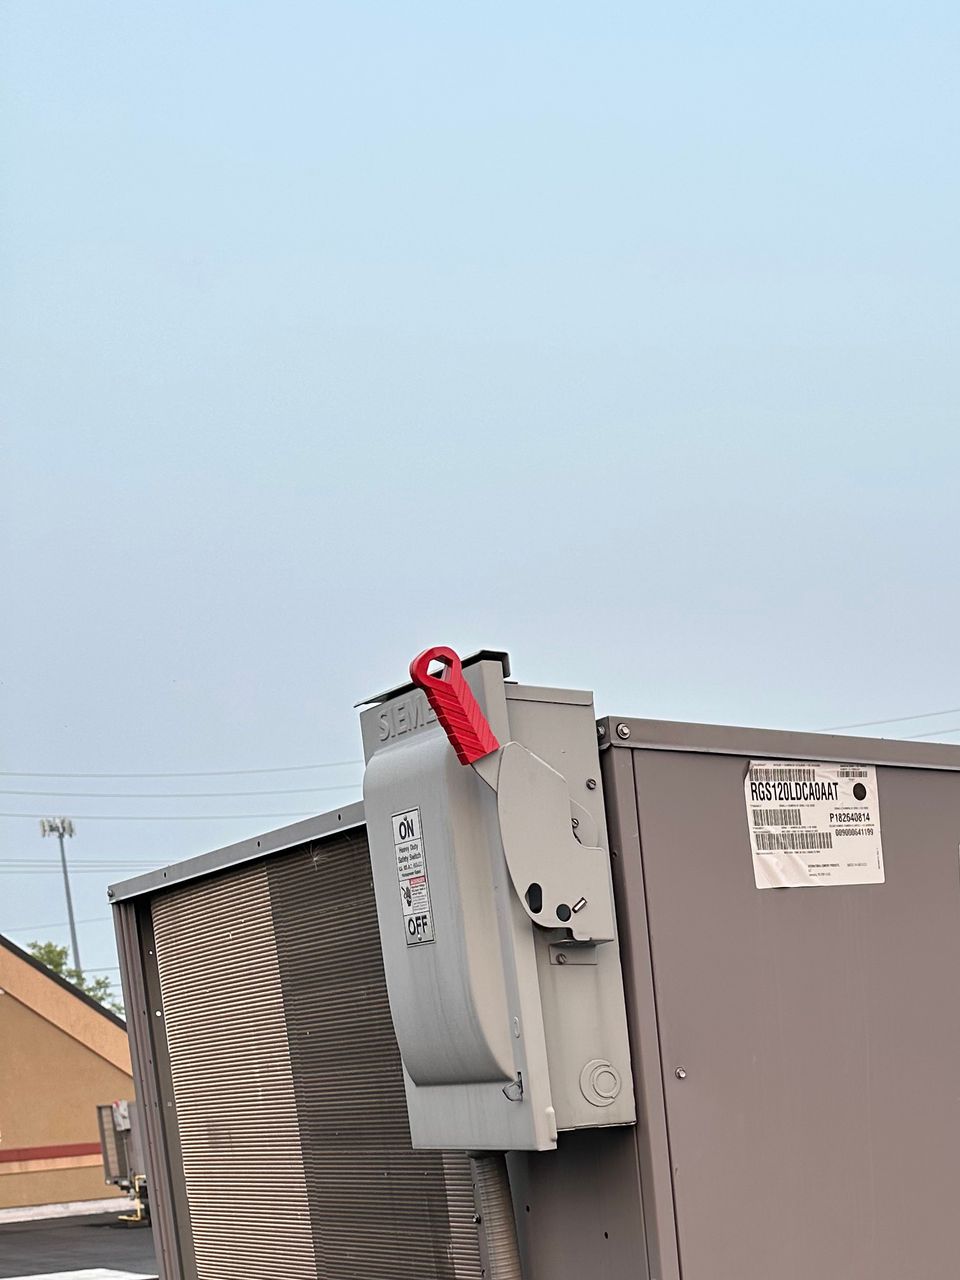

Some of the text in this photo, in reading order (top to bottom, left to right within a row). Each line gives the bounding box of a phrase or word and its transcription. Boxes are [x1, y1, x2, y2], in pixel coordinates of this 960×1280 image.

[751, 782, 838, 800] RGS120LDCA0AAT
[399, 819, 414, 840] ON
[408, 915, 427, 935] OFF
